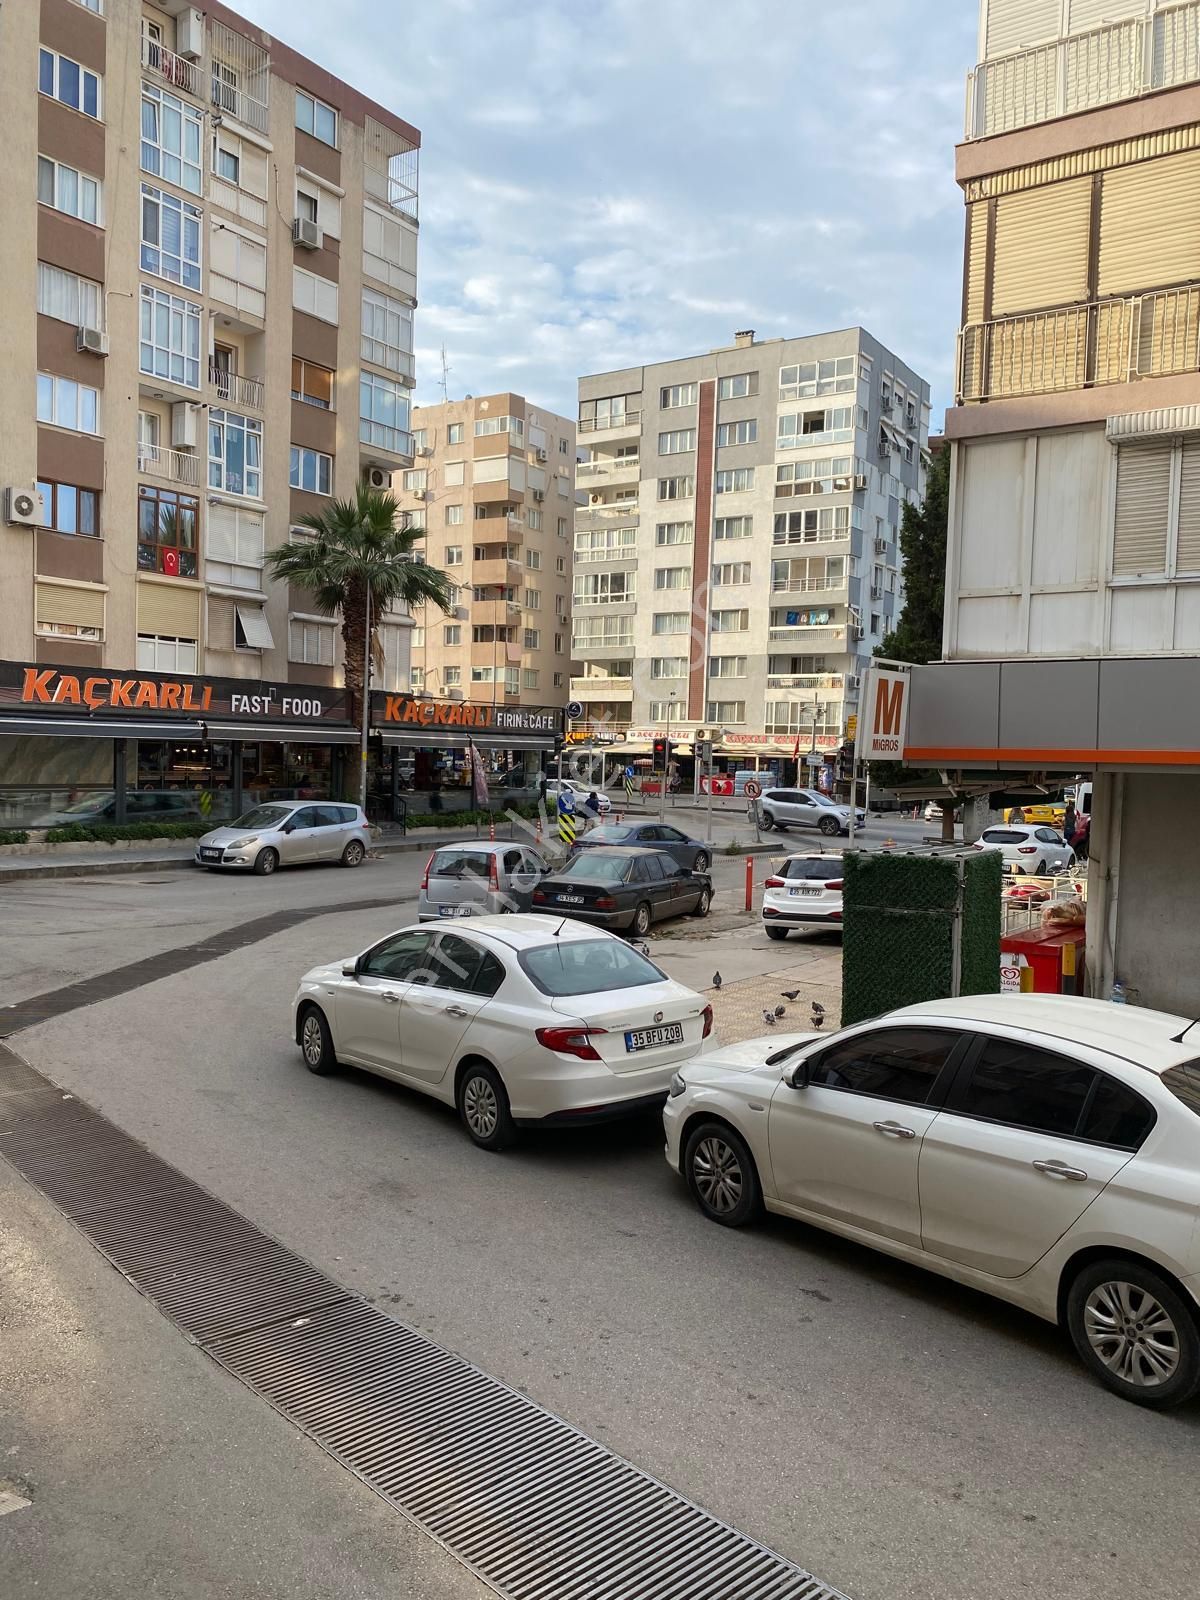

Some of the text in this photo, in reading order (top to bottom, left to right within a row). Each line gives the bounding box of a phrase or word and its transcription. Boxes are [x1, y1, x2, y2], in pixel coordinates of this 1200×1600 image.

[23, 668, 321, 716] KAÇKARLI FAST FOOD
[873, 678, 904, 736] M
[385, 696, 492, 727] KAÇKARLI
[497, 712, 522, 727] FIRIN
[529, 714, 553, 729] CAFE
[632, 1033, 645, 1046] 35
[646, 1029, 663, 1044] BFU
[664, 1026, 681, 1040] 208
